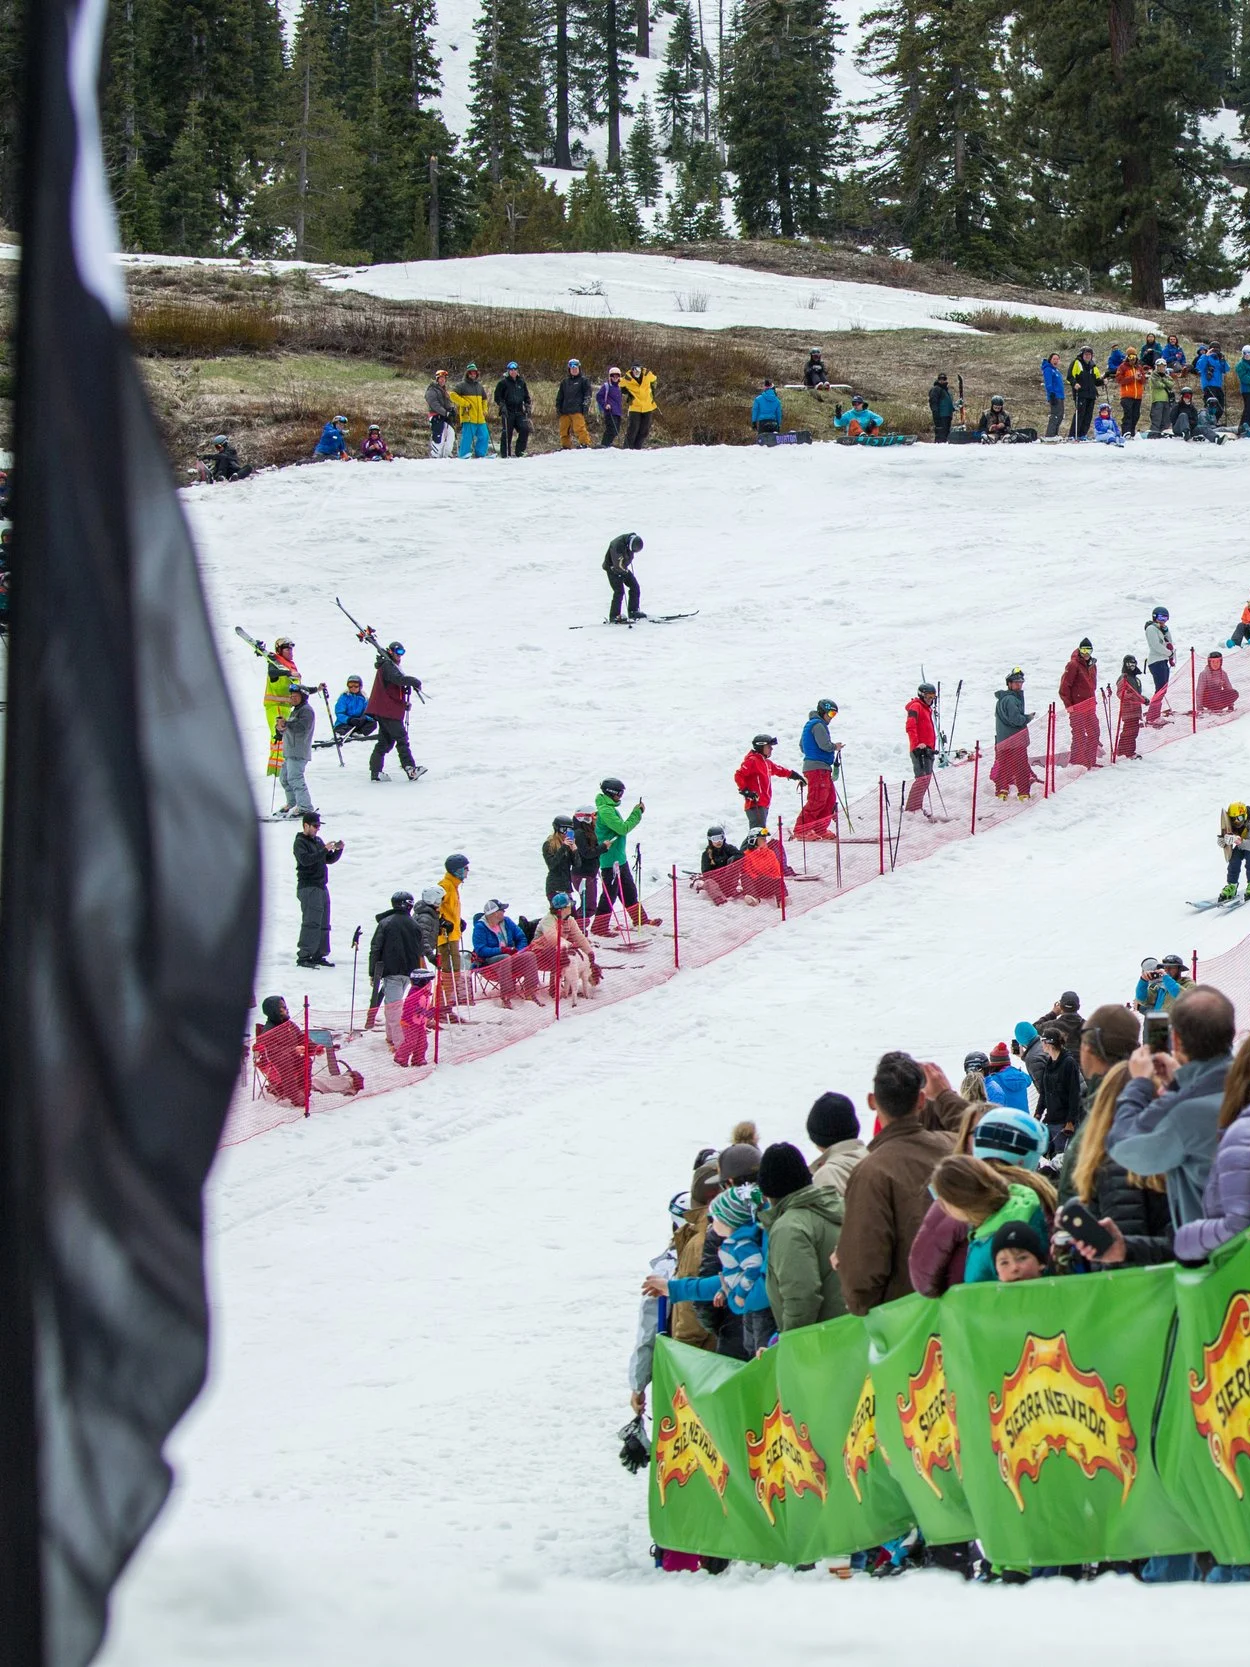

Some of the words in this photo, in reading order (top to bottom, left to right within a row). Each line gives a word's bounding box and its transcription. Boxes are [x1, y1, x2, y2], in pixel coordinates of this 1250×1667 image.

[776, 434, 797, 444] BURTON
[1005, 1391, 1045, 1448] SIERRA
[1043, 1387, 1107, 1446] NEVADA
